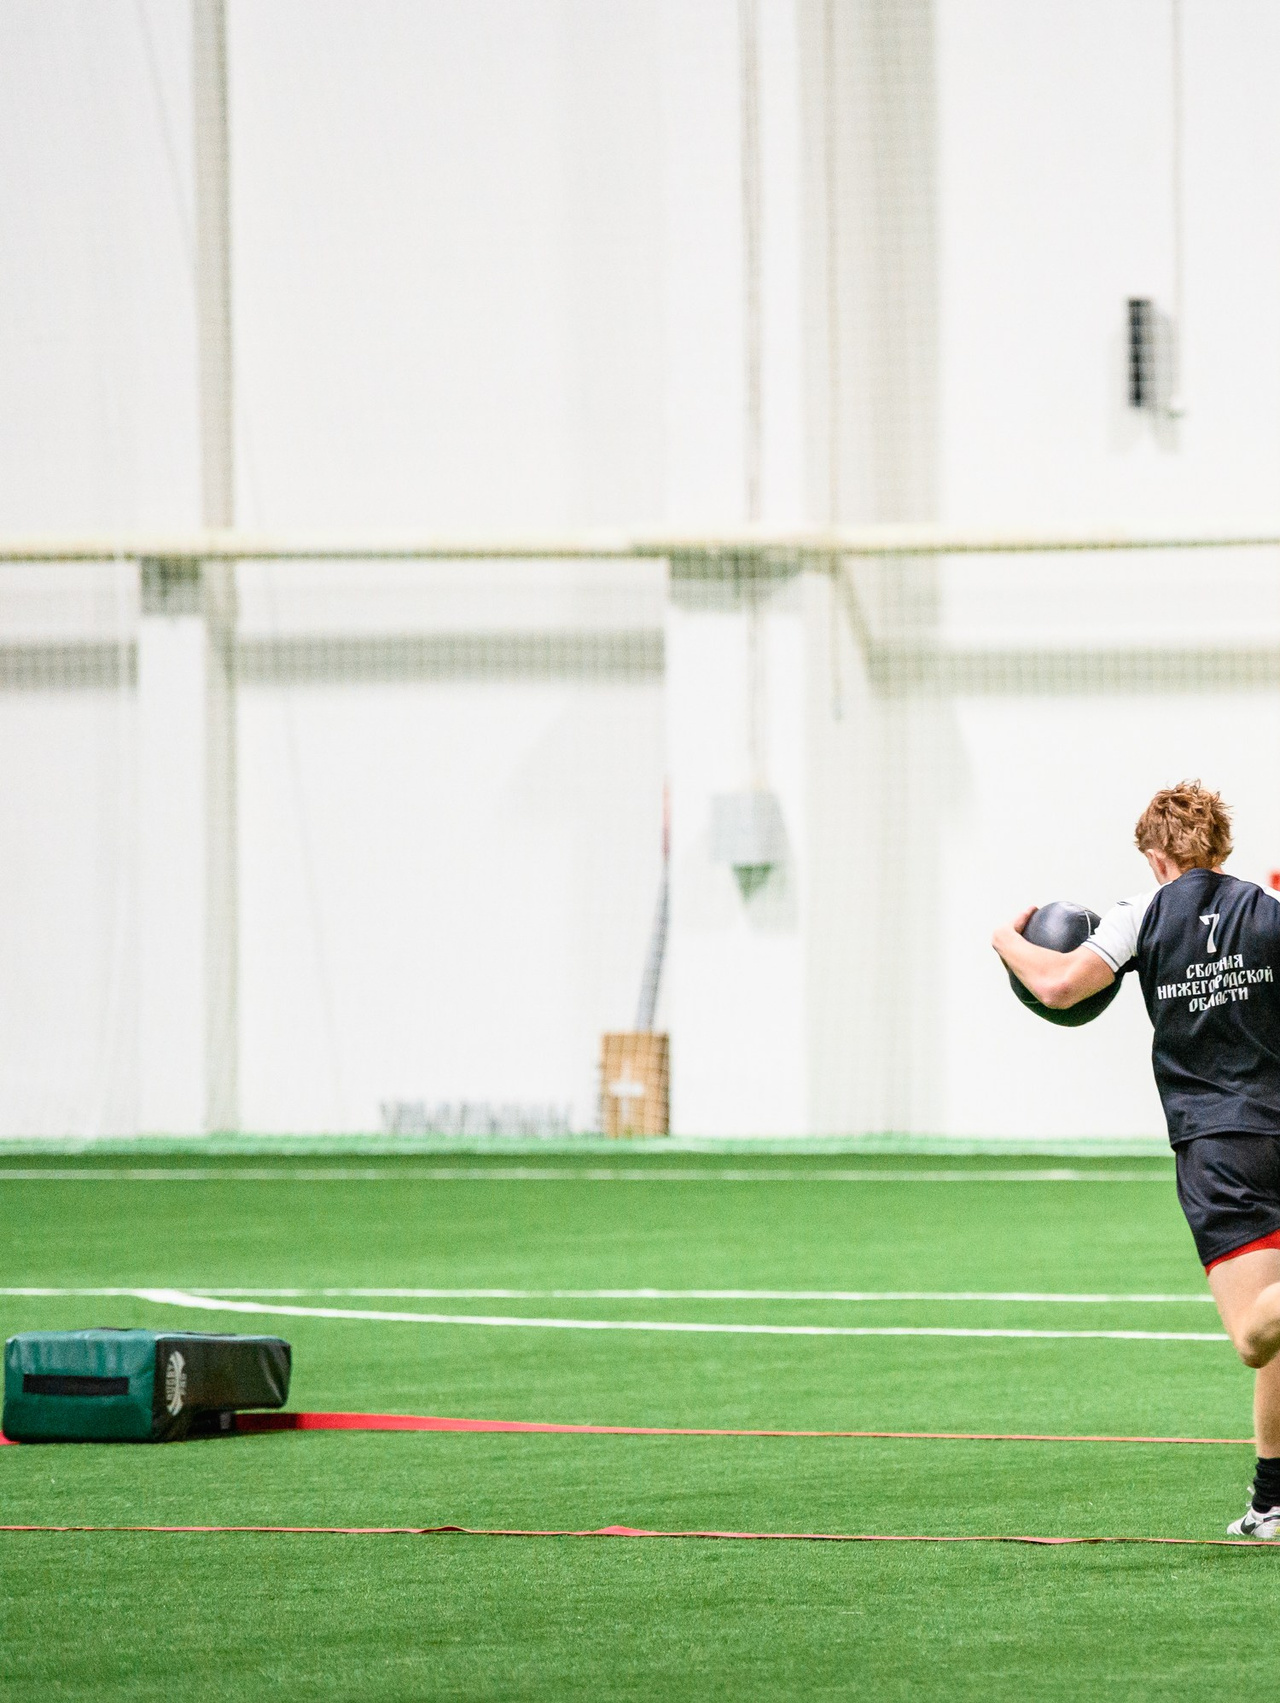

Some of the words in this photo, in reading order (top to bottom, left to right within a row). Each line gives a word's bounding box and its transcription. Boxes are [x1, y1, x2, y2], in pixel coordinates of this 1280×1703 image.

[1199, 913, 1220, 953] 7
[1186, 954, 1244, 979] СБОРНАЯ
[1157, 967, 1274, 1000] НИЖЕГОРОДСКОЙ
[1189, 987, 1249, 1012] ОБЛАСТИ
